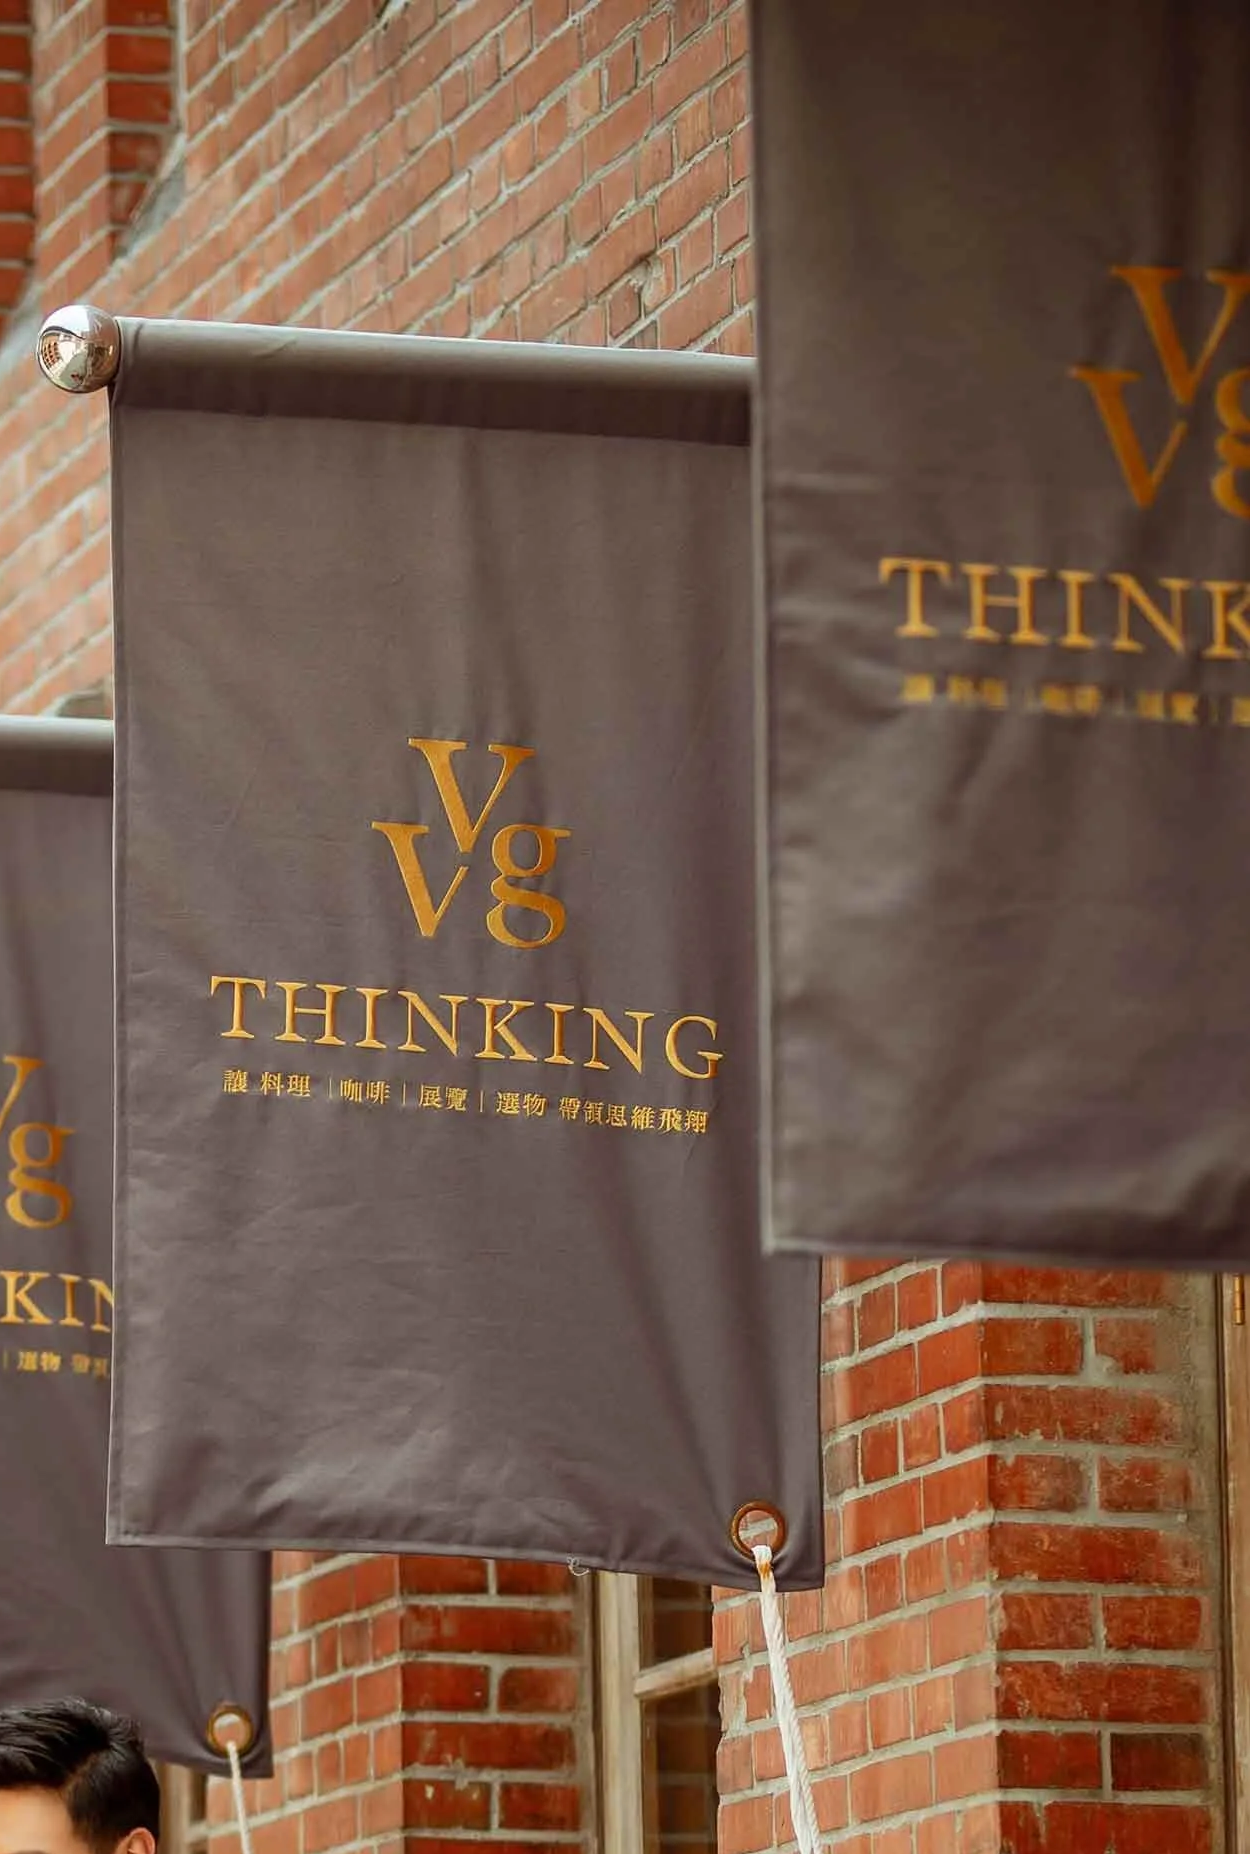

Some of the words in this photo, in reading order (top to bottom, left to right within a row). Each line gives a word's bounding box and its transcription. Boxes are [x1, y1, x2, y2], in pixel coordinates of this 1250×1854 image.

[879, 556, 1250, 662] THINK
[210, 975, 724, 1080] THINKING
[260, 1071, 312, 1098] 料理
[340, 1078, 390, 1105] 咖啡
[496, 1091, 548, 1118] 選物
